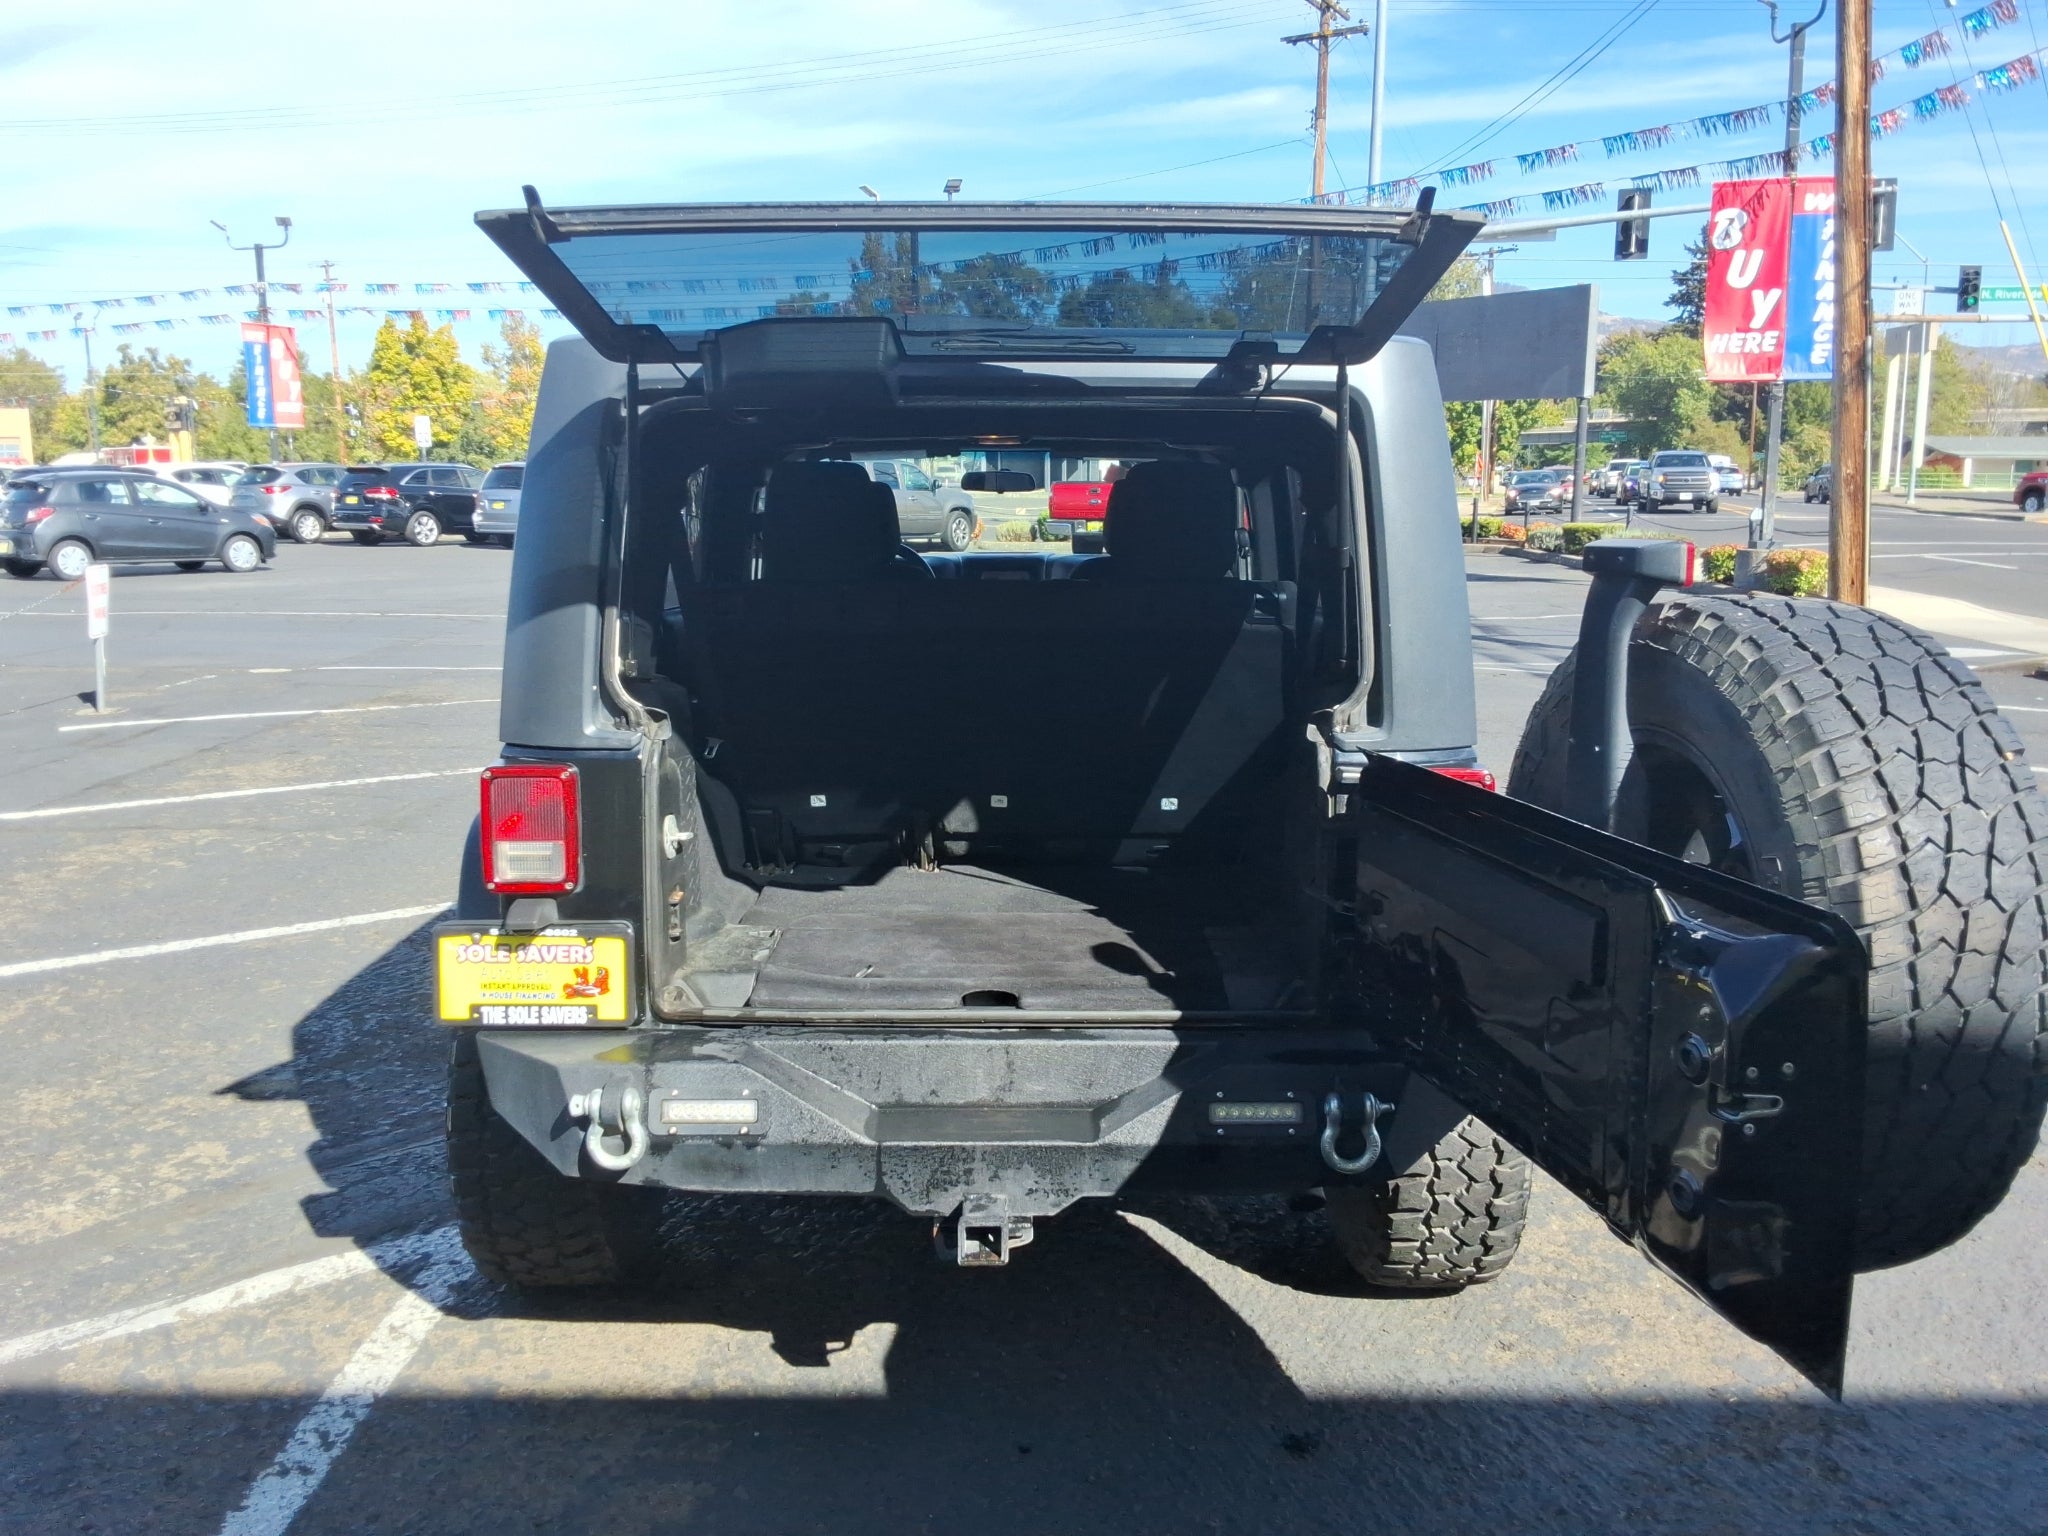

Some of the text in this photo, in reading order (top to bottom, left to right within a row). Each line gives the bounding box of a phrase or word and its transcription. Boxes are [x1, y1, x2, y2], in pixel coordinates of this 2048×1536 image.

[1711, 207, 1783, 330] BUY
[1898, 291, 1916, 300] ONE
[1995, 289, 2042, 299] Riversde
[1899, 301, 1917, 309] WAY
[1710, 330, 1780, 354] HERE
[457, 944, 594, 964] SOLE SAVERS
[480, 1005, 588, 1025] THE SOLE SAVERS
